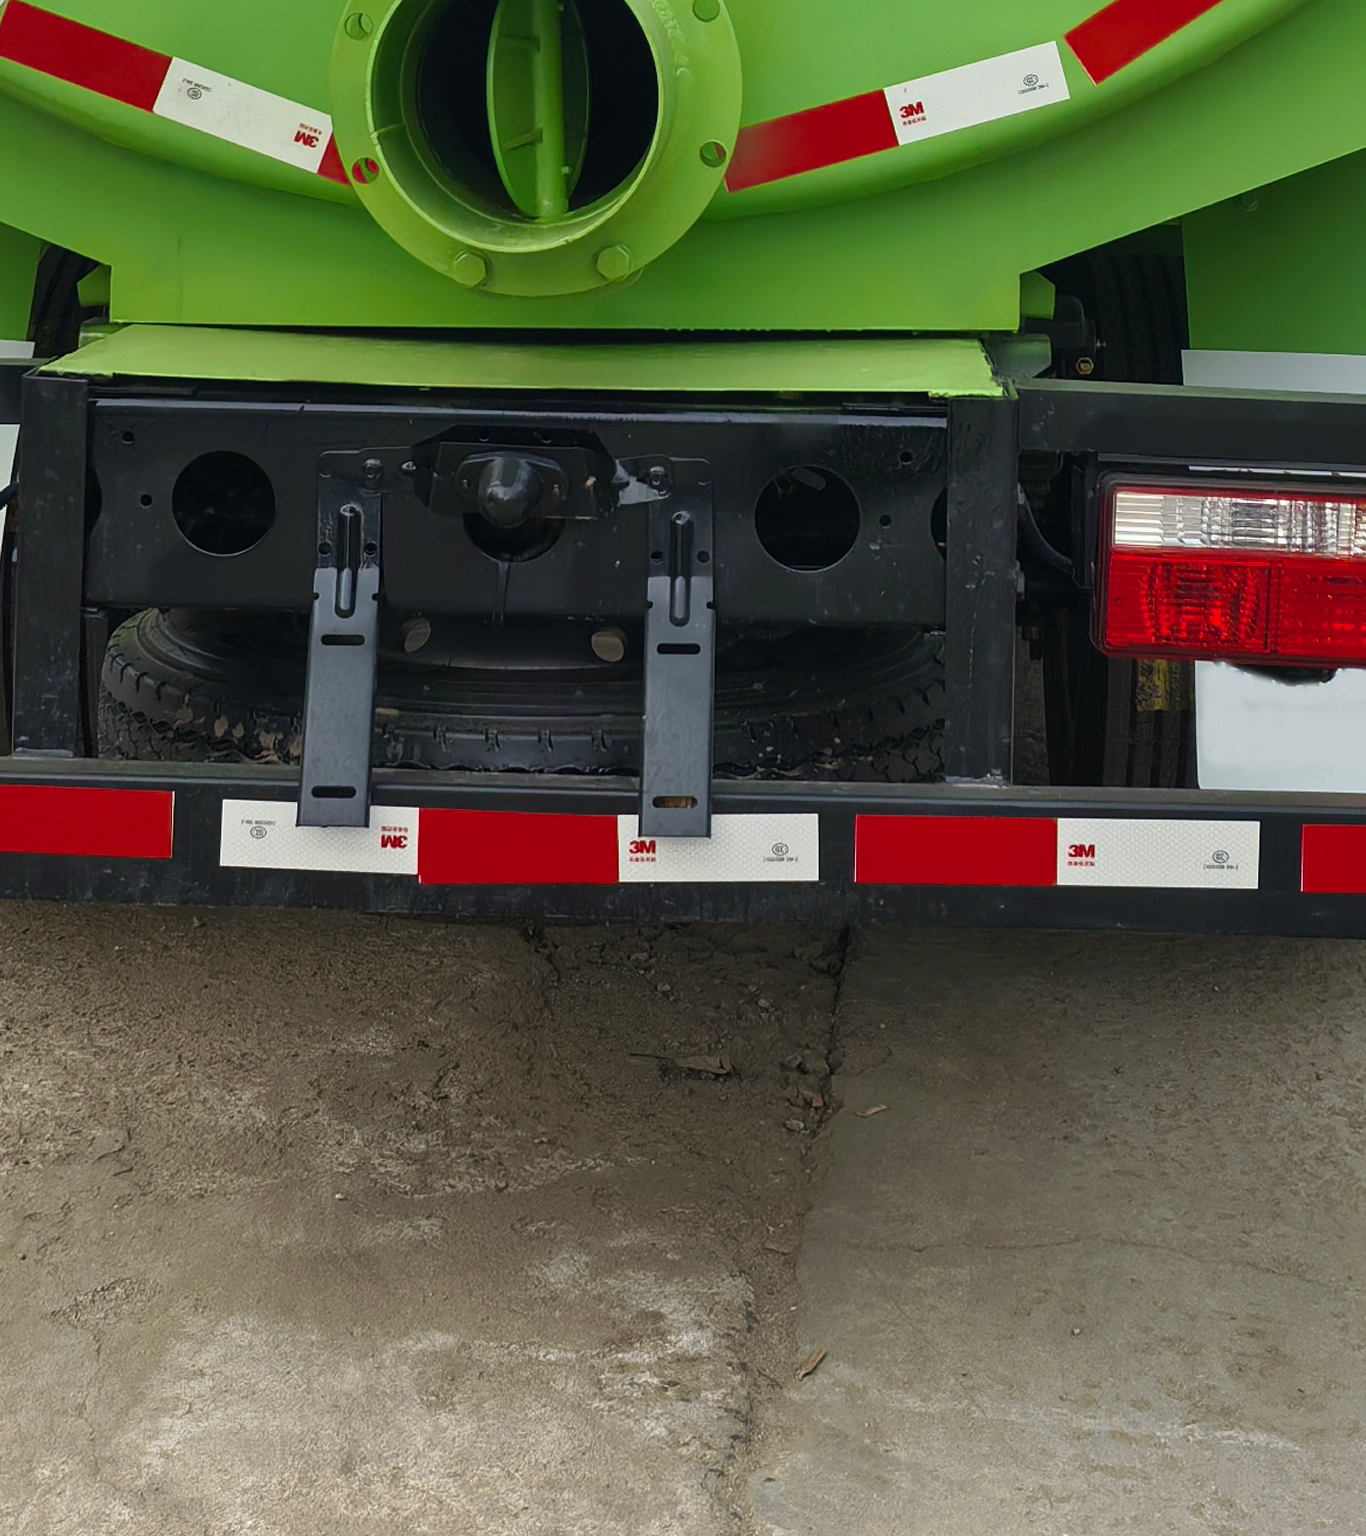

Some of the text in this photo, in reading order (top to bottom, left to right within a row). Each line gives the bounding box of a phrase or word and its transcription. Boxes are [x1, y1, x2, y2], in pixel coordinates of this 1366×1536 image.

[899, 101, 925, 119] 3M
[293, 129, 319, 149] 3M
[380, 834, 408, 850] 3M
[629, 839, 657, 855] 3M
[1068, 844, 1096, 860] 3M
